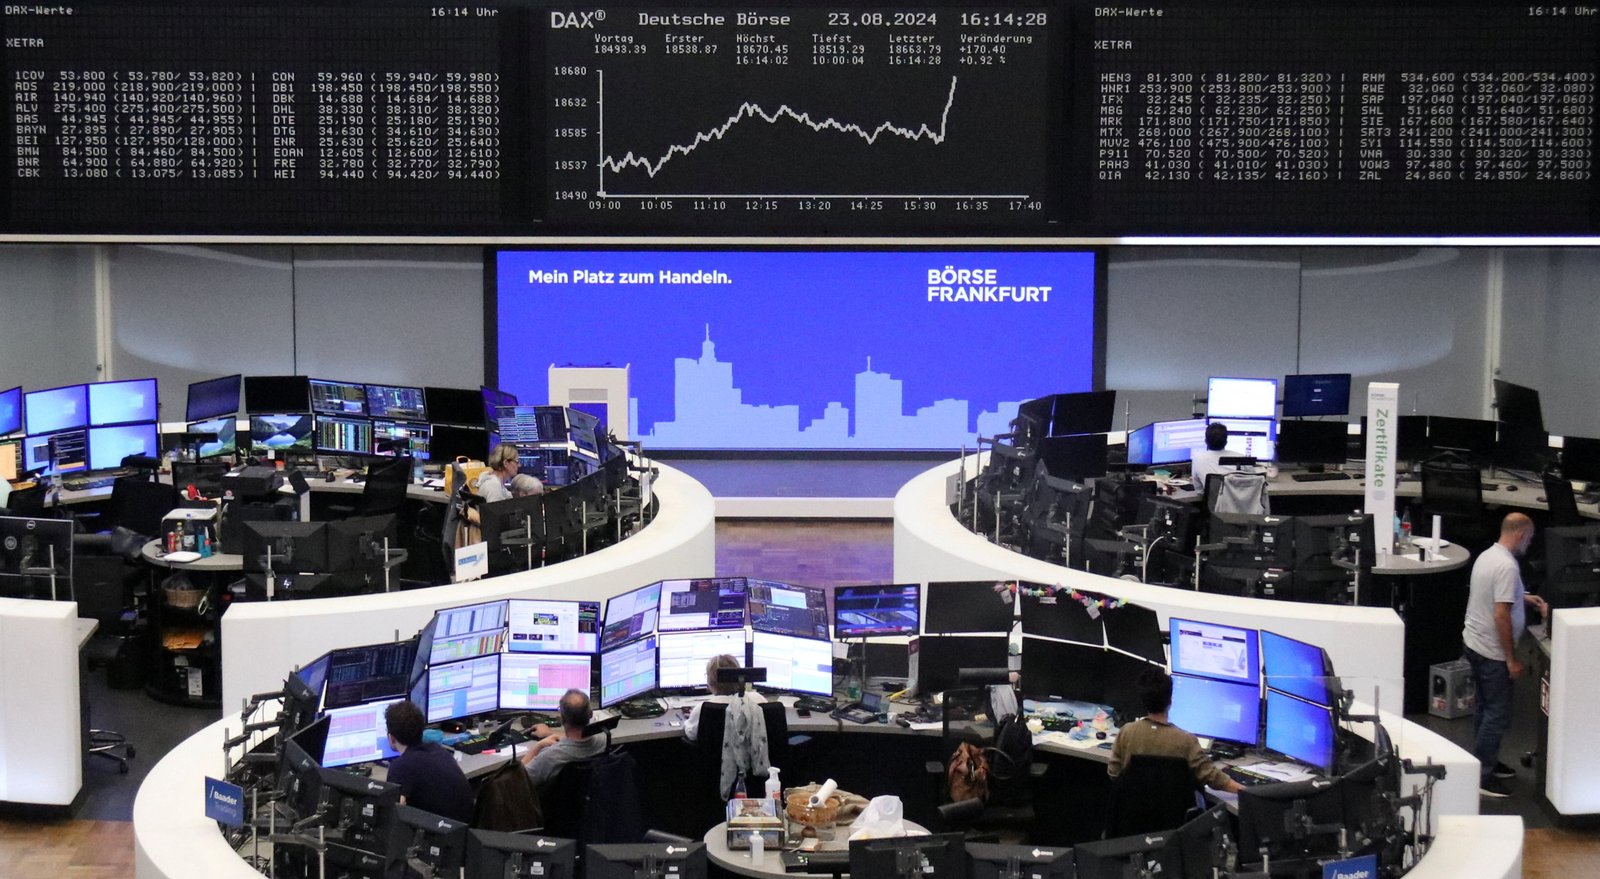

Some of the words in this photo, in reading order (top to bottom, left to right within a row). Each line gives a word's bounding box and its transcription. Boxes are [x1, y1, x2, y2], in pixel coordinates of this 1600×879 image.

[5, 6, 72, 14] DAX-Werte
[432, 8, 467, 16] 16:14
[477, 8, 498, 16] Uhr
[1095, 8, 1163, 16] DAX-Werte
[1529, 7, 1566, 15] 16:14
[1575, 7, 1597, 15] Uhr
[639, 13, 724, 25] Deutsche
[737, 12, 790, 25] Börse
[829, 13, 936, 26] 23.08.2024
[961, 13, 1046, 26] 16:14:28
[595, 34, 633, 43] Vortag
[666, 34, 704, 42] Erster
[737, 34, 775, 42] Höchst
[812, 34, 851, 42] Tiefst
[890, 34, 934, 42] Letzter
[961, 34, 1032, 44] Veränderung
[7, 38, 43, 47] XETRA
[1095, 41, 1131, 49] XETRA
[595, 45, 646, 53] 18493.39
[666, 45, 717, 53] 18538.87
[737, 45, 788, 53] 18670.45
[813, 45, 864, 54] 18519.29
[890, 45, 941, 53] 18663.79
[960, 45, 1005, 53] +170.40
[737, 56, 788, 64] 16:14:02
[813, 56, 864, 64] 10:00:04
[890, 56, 941, 64] 16:14:28
[960, 56, 992, 64] +0.92
[555, 67, 586, 75] 18680
[16, 71, 44, 80] 1COV
[60, 71, 105, 80] 53,800
[273, 72, 294, 81] CON
[318, 73, 362, 81] 59,960
[1101, 73, 1131, 82] HEN3
[1363, 73, 1385, 82] RHM
[15, 82, 37, 90] ADS
[53, 82, 105, 91] 219,000
[273, 83, 293, 92] DB1
[312, 83, 362, 92] 198,450
[1101, 84, 1129, 93] HNR1
[1362, 84, 1384, 93] RWE
[16, 93, 37, 101] AIR
[55, 93, 105, 102] 140,940
[273, 94, 294, 103] DBK
[320, 94, 363, 103] 14,688
[1102, 95, 1123, 104] IFX
[1362, 95, 1384, 103] SAP
[555, 98, 586, 107] 18632
[16, 104, 38, 112] ALV
[54, 104, 106, 112] 275,400
[273, 105, 295, 113] DHL
[319, 105, 363, 114] 38,330
[1101, 106, 1122, 114] MBG
[1362, 106, 1383, 114] SHL
[16, 114, 38, 123] BAS
[62, 115, 106, 123] 44,945
[274, 116, 295, 124] DTE
[319, 116, 363, 124] 25,190
[1101, 117, 1122, 125] MRK
[1361, 117, 1383, 125] SIE
[17, 125, 46, 134] BAYN
[62, 125, 106, 134] 27,895
[274, 127, 295, 135] DTG
[319, 127, 363, 135] 34,630
[555, 129, 586, 137] 18585
[1100, 128, 1122, 136] MTX
[1361, 128, 1391, 136] SRT3
[17, 136, 37, 144] BEI
[56, 136, 107, 145] 127,950
[274, 137, 295, 146] ENR
[319, 137, 363, 146] 25,630
[1100, 139, 1129, 147] MUV2
[1361, 139, 1381, 147] SY1
[17, 147, 39, 155] BMW
[63, 147, 107, 156] 84,500
[274, 148, 303, 157] EOAN
[321, 148, 363, 157] 12,605
[1100, 149, 1128, 158] P911
[1360, 150, 1382, 158] VNA
[18, 158, 39, 166] BNR
[63, 158, 107, 166] 64,900
[274, 159, 295, 167] FRE
[320, 159, 363, 168] 32,780
[556, 161, 587, 169] 18537
[1100, 160, 1129, 169] PAH3
[1360, 160, 1389, 169] VOW3
[18, 168, 39, 177] CBK
[64, 169, 107, 177] 13,080
[275, 170, 295, 178] HEI
[320, 170, 364, 178] 94,440
[1099, 171, 1121, 179] QIA
[1360, 171, 1381, 180] ZAL
[556, 191, 587, 200] 18490
[589, 201, 620, 209] 09:00
[641, 201, 672, 209] 10:05
[694, 201, 725, 209] 11:10
[746, 201, 777, 209] 12:15
[800, 201, 830, 210] 13:20
[851, 201, 882, 210] 14:25
[905, 201, 935, 210] 15:30
[957, 202, 988, 210] 16:35
[1010, 202, 1041, 210] 17:40
[529, 270, 568, 283] Mein
[574, 270, 614, 283] Platz
[619, 273, 654, 283] zum
[660, 270, 732, 284] Handeln.
[928, 266, 997, 284] BÖRSE
[928, 287, 1052, 302] FRANKFURT
[1374, 409, 1389, 487] Zertifikate
[213, 790, 238, 805] Baader
